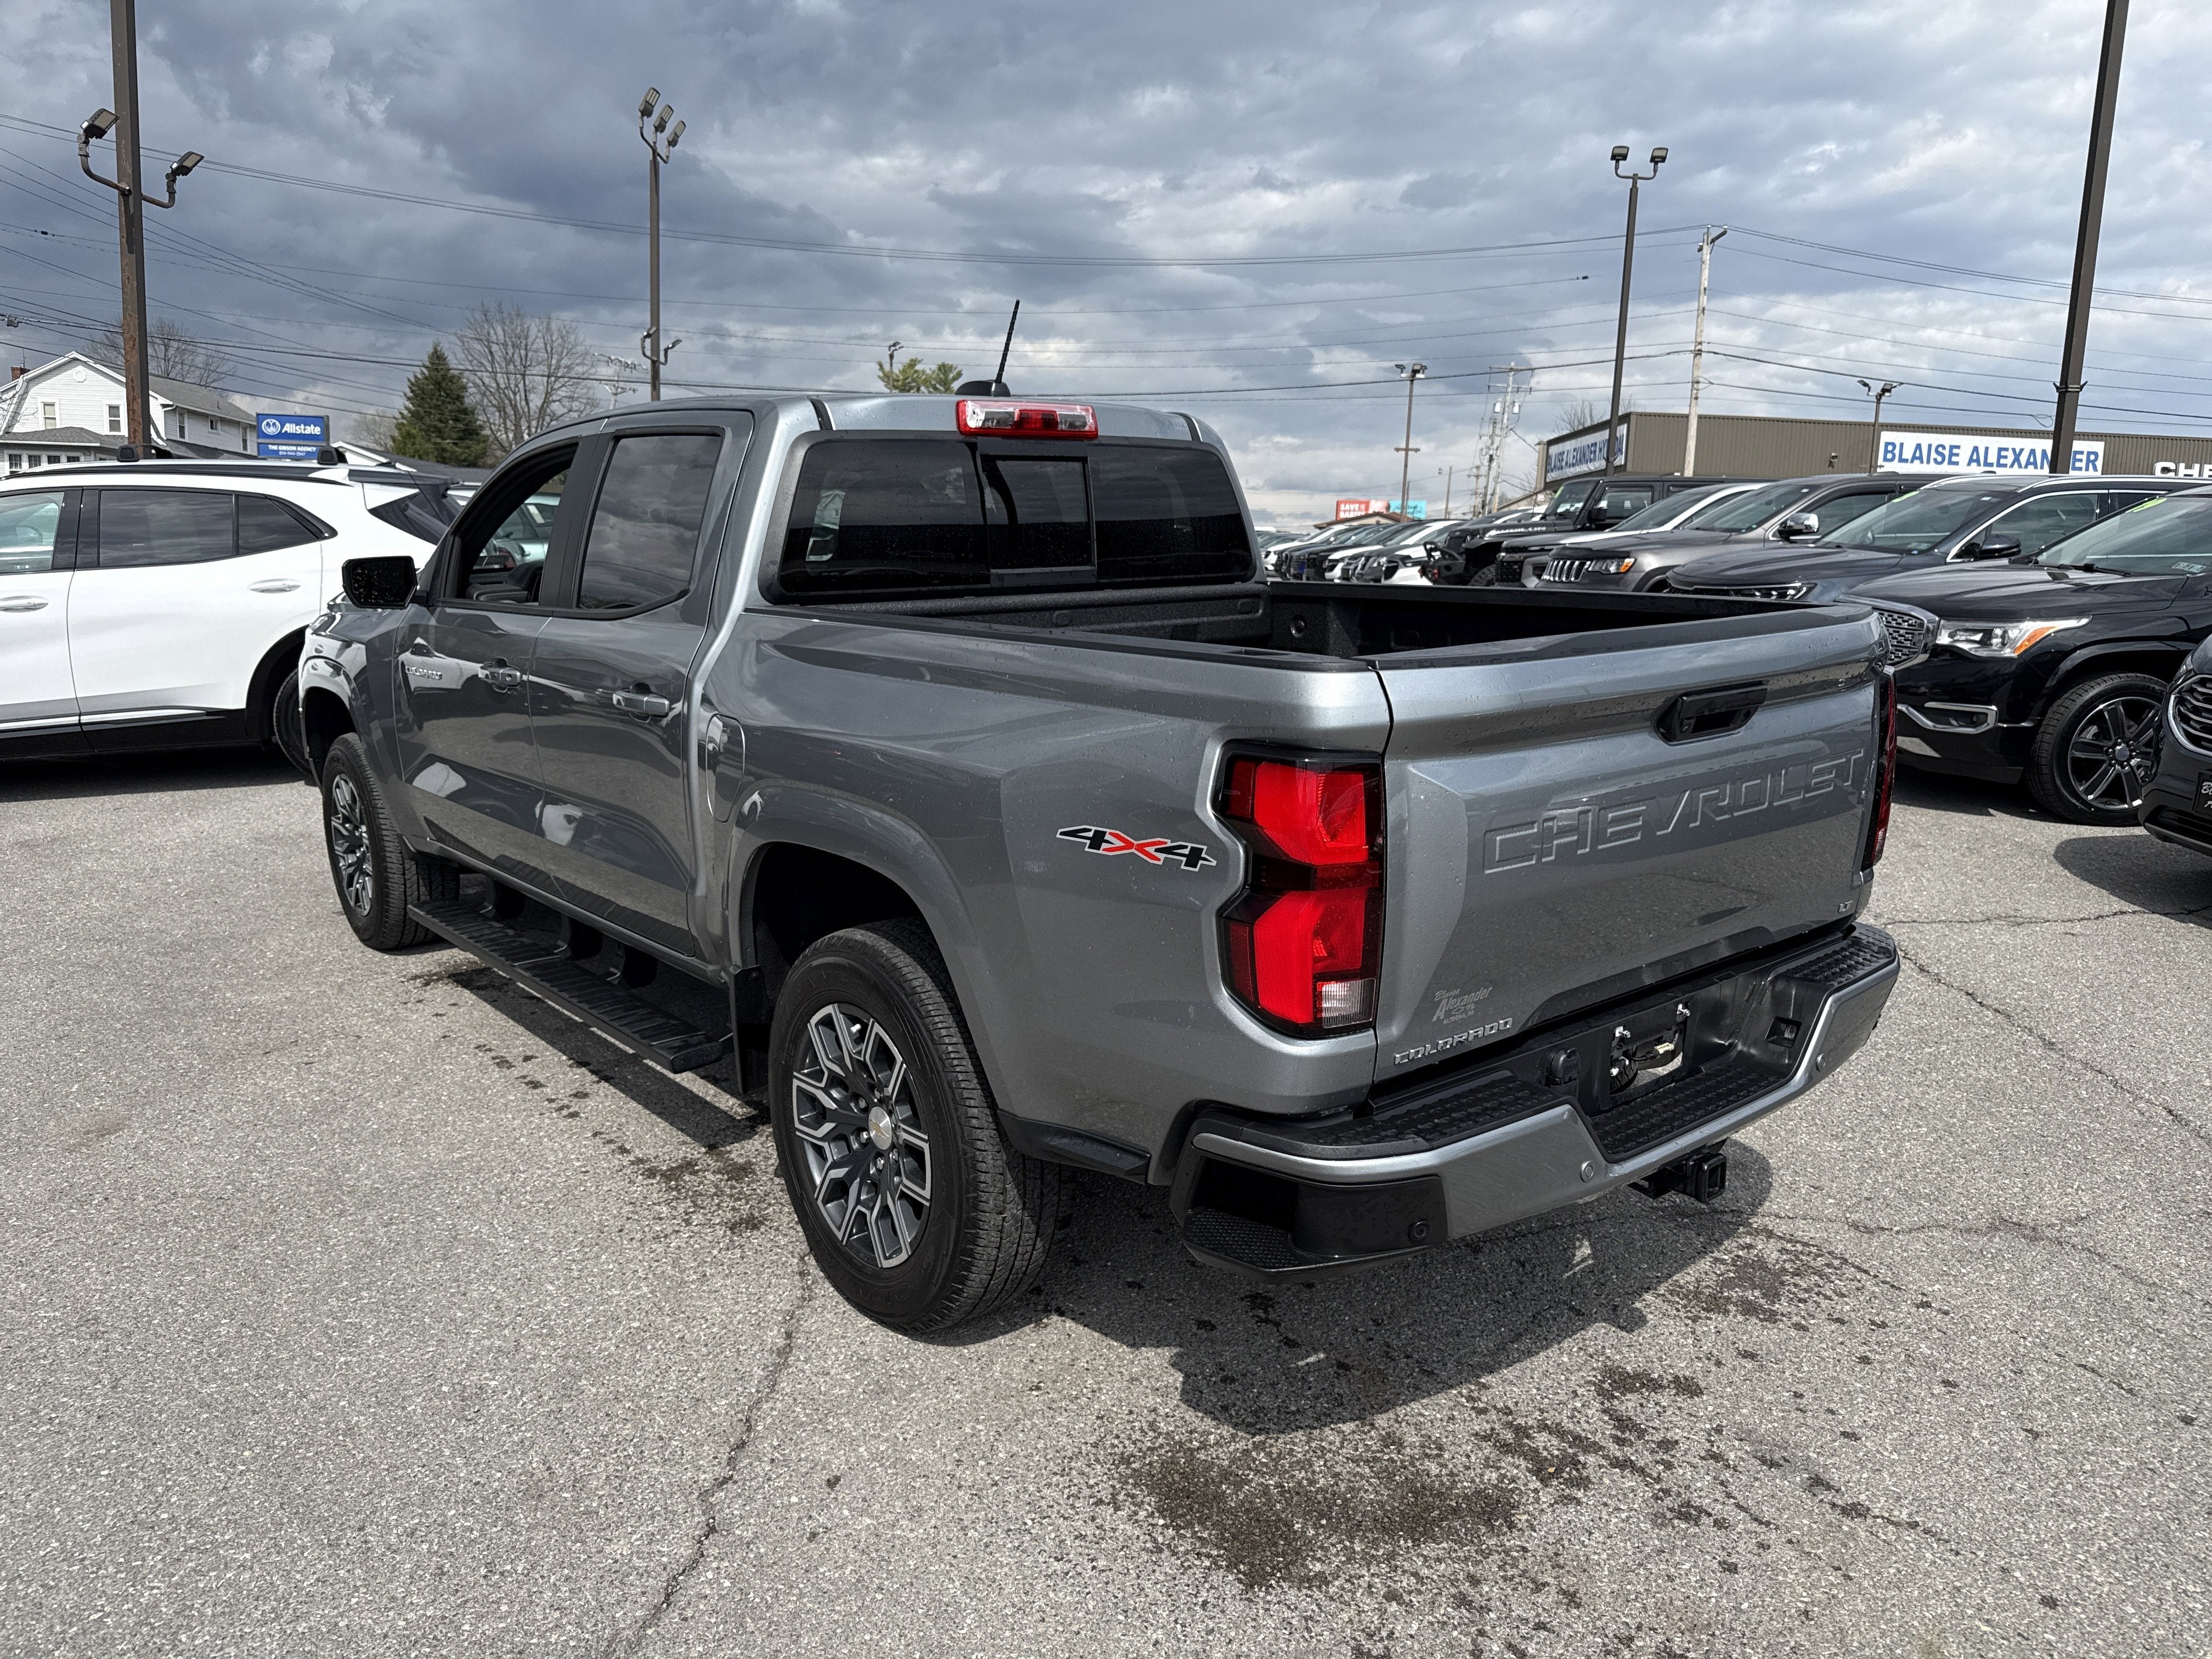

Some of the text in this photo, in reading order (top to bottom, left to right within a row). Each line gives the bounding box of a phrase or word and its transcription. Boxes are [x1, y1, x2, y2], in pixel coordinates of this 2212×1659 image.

[281, 423, 321, 435] Allstate
[1547, 451, 1564, 473] BLAISE
[1565, 442, 1598, 470] ALEXANDER
[1882, 442, 2099, 472] BLAISE ALEXANER
[1483, 748, 1864, 874] CHEVROLET
[1838, 900, 1853, 913] LT
[1432, 986, 1493, 1022] Alexander
[1434, 989, 1461, 1001] Blaise
[1443, 1013, 1467, 1025] ALTOONA,
[1394, 1017, 1513, 1065] COLORADO
